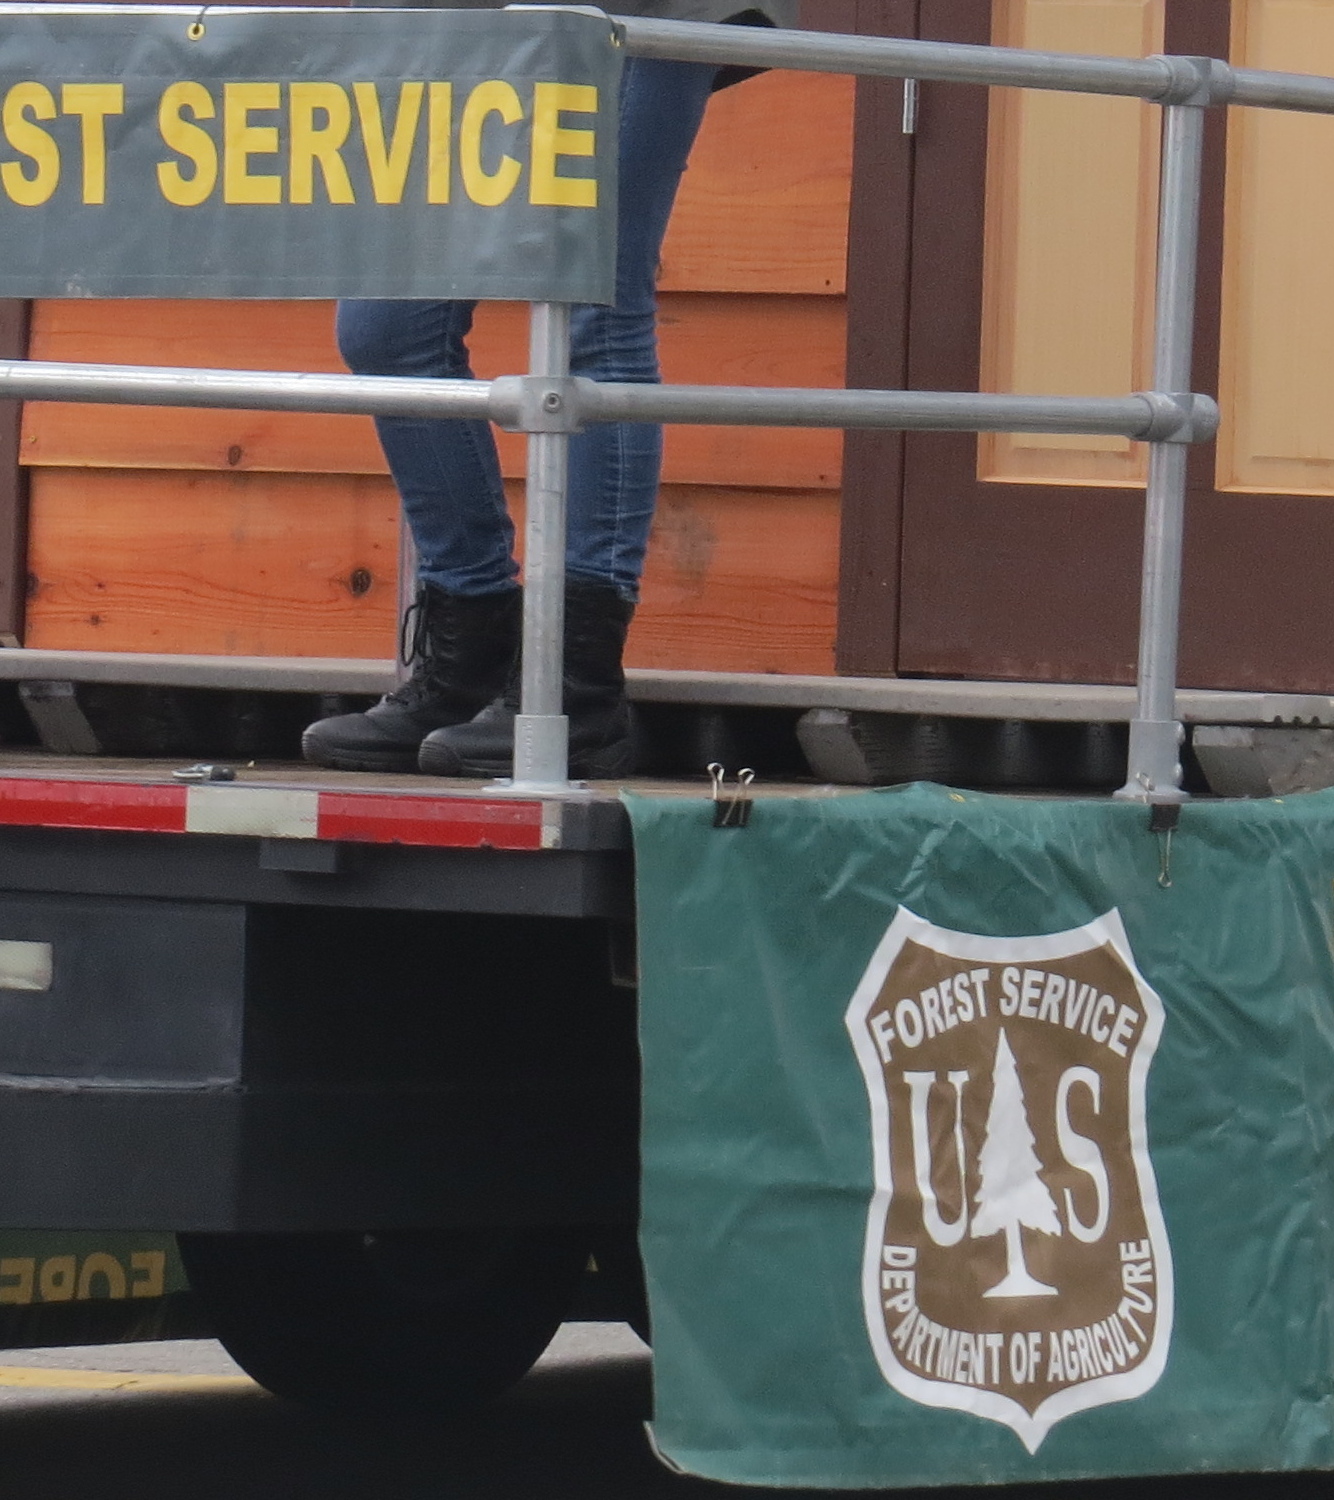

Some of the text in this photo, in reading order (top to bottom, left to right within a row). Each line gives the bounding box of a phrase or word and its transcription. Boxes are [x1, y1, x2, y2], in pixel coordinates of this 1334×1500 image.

[157, 80, 598, 208] SERVICE
[870, 966, 1139, 1064] FOREST SERVICE
[881, 1238, 1154, 1385] DEPARTMENT OF AGRICULTURE
